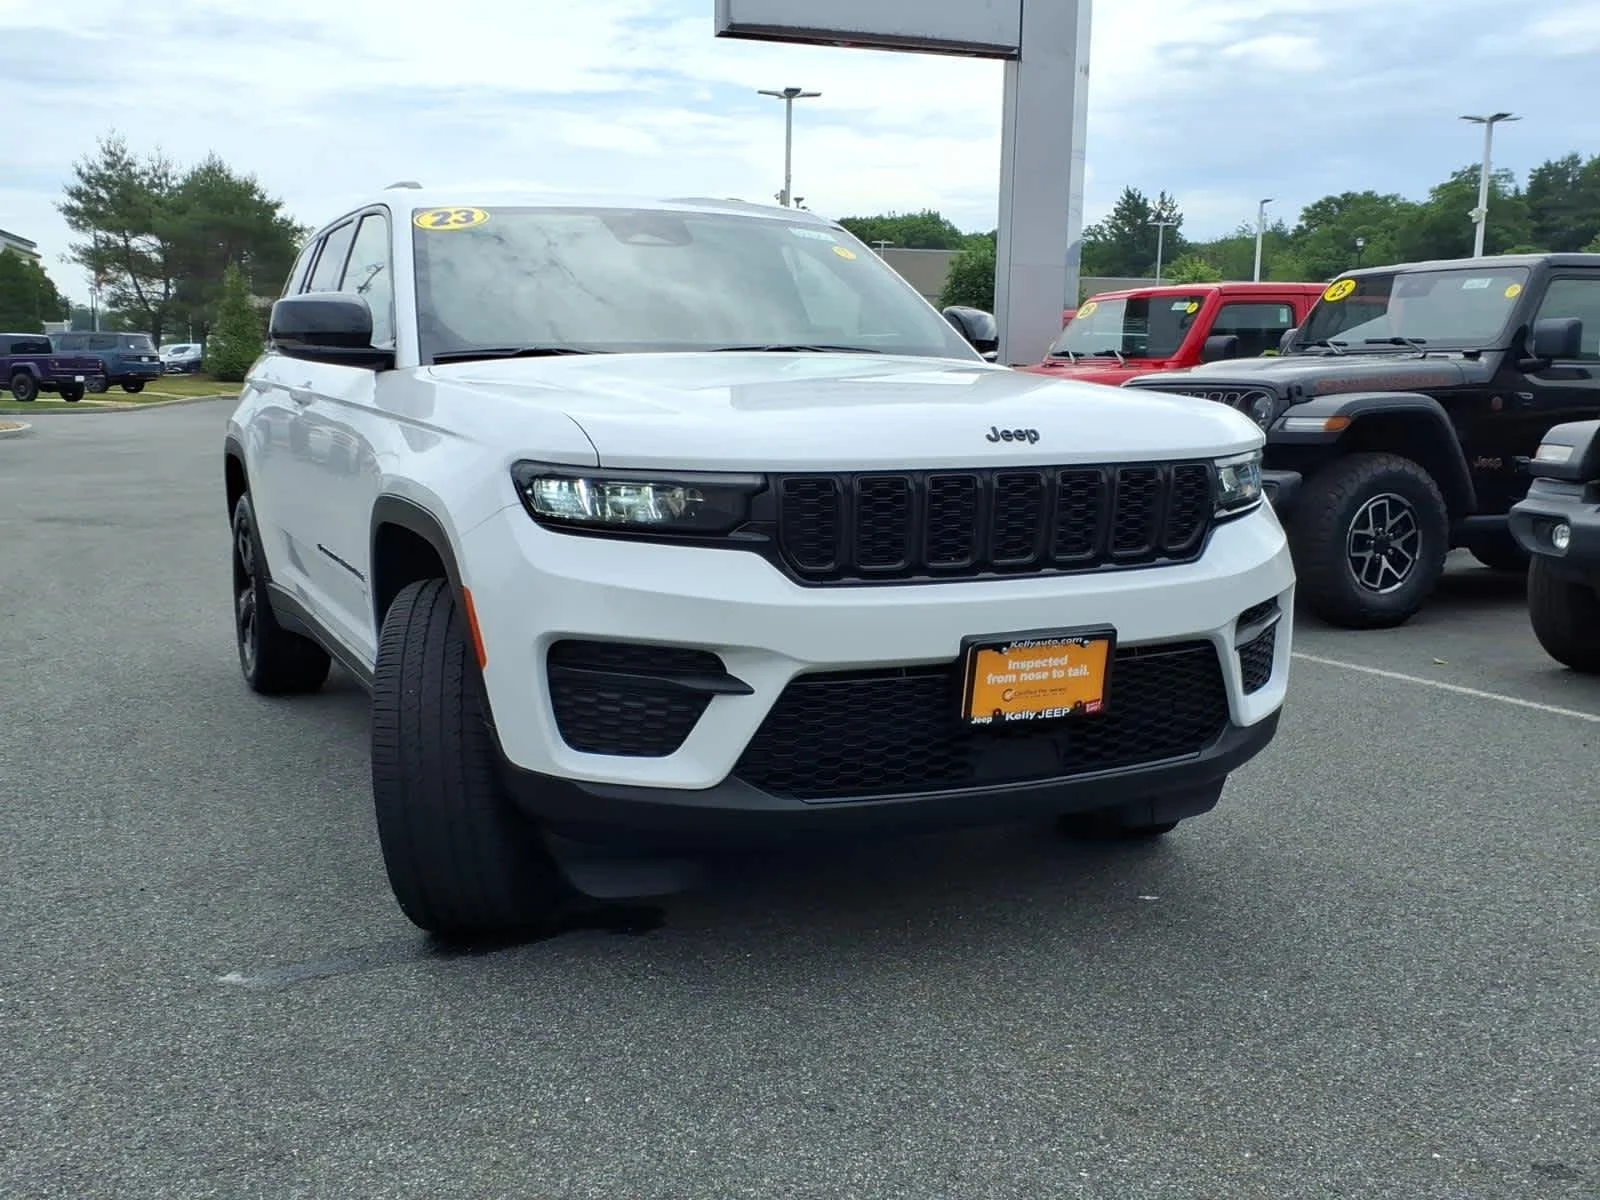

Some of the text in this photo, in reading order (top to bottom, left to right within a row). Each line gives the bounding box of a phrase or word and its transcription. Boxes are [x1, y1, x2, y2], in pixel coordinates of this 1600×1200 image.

[431, 209, 474, 227] 23
[985, 426, 1040, 445] Jeep
[1007, 655, 1068, 671] Inspected
[987, 664, 1089, 685] from nose to tail.
[971, 716, 993, 725] Jeep
[1005, 707, 1070, 721] Kelly JEEP
